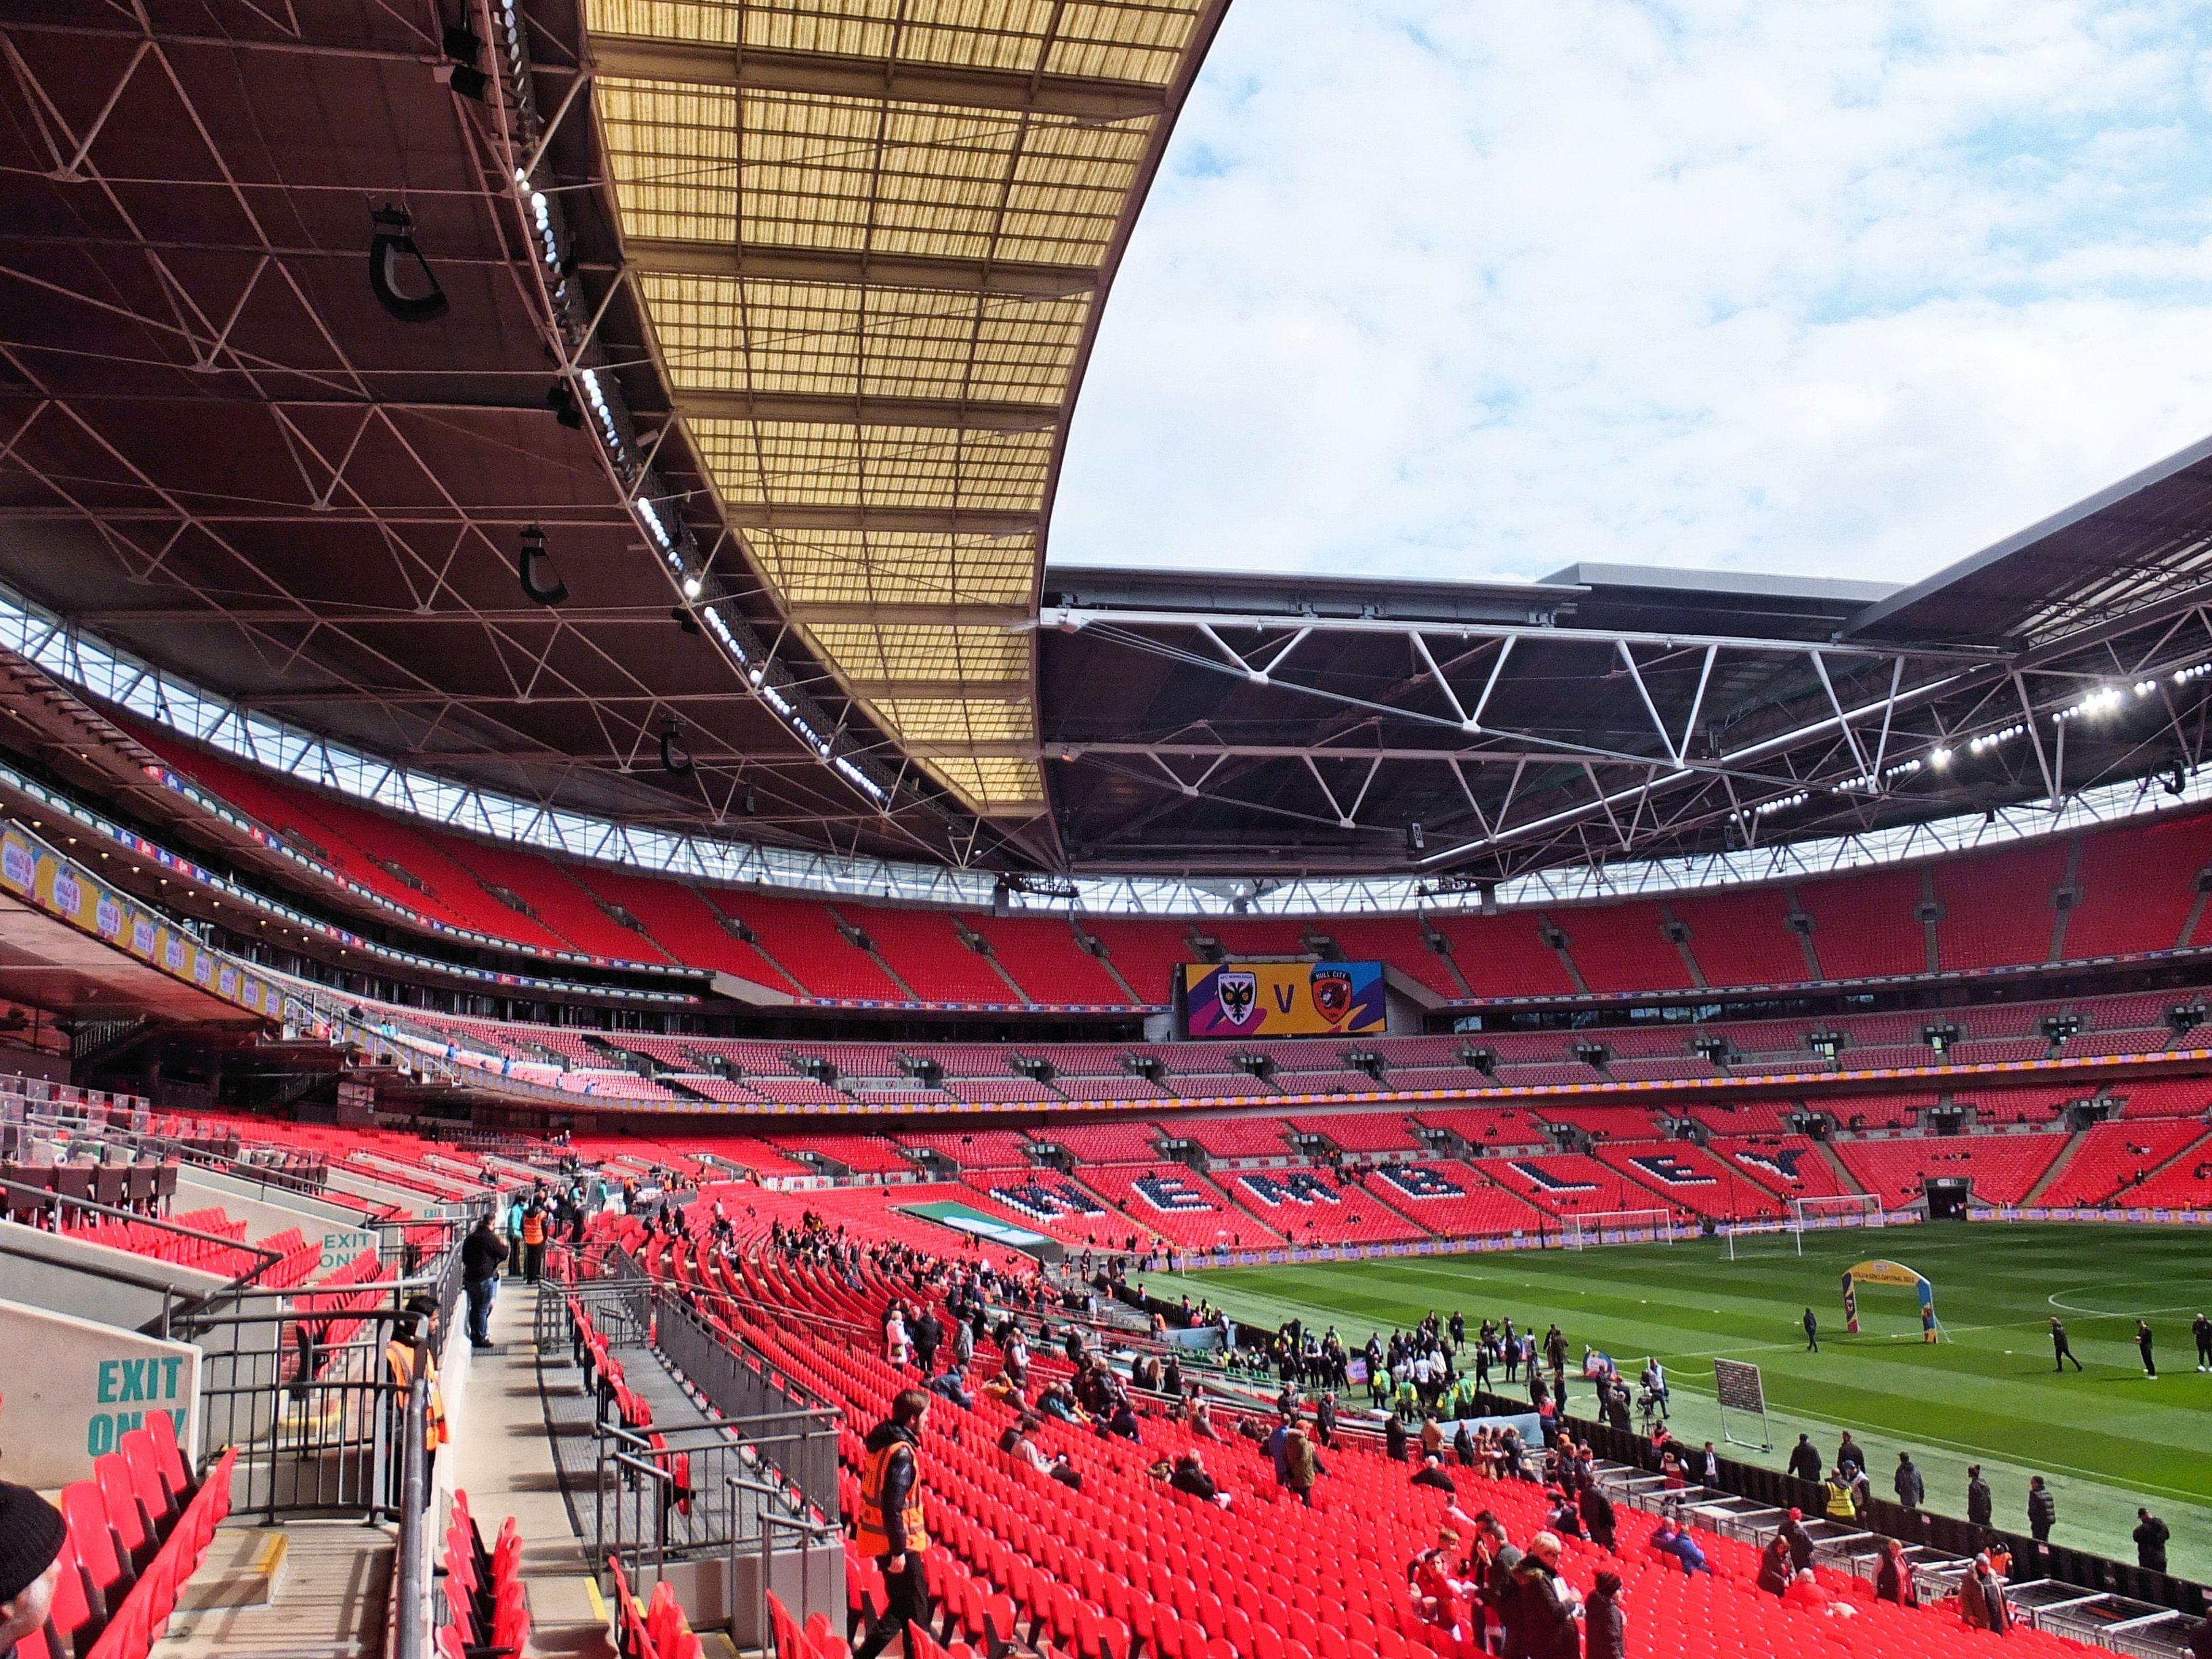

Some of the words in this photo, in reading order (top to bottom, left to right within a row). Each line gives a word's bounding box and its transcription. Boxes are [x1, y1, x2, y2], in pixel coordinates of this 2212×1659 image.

[1315, 970, 1329, 980] HULL
[1332, 970, 1346, 979] CITY
[1273, 984, 1294, 1013] V
[324, 1233, 370, 1249] EXIT
[319, 1252, 356, 1268] ON
[98, 1357, 183, 1403] EXIT
